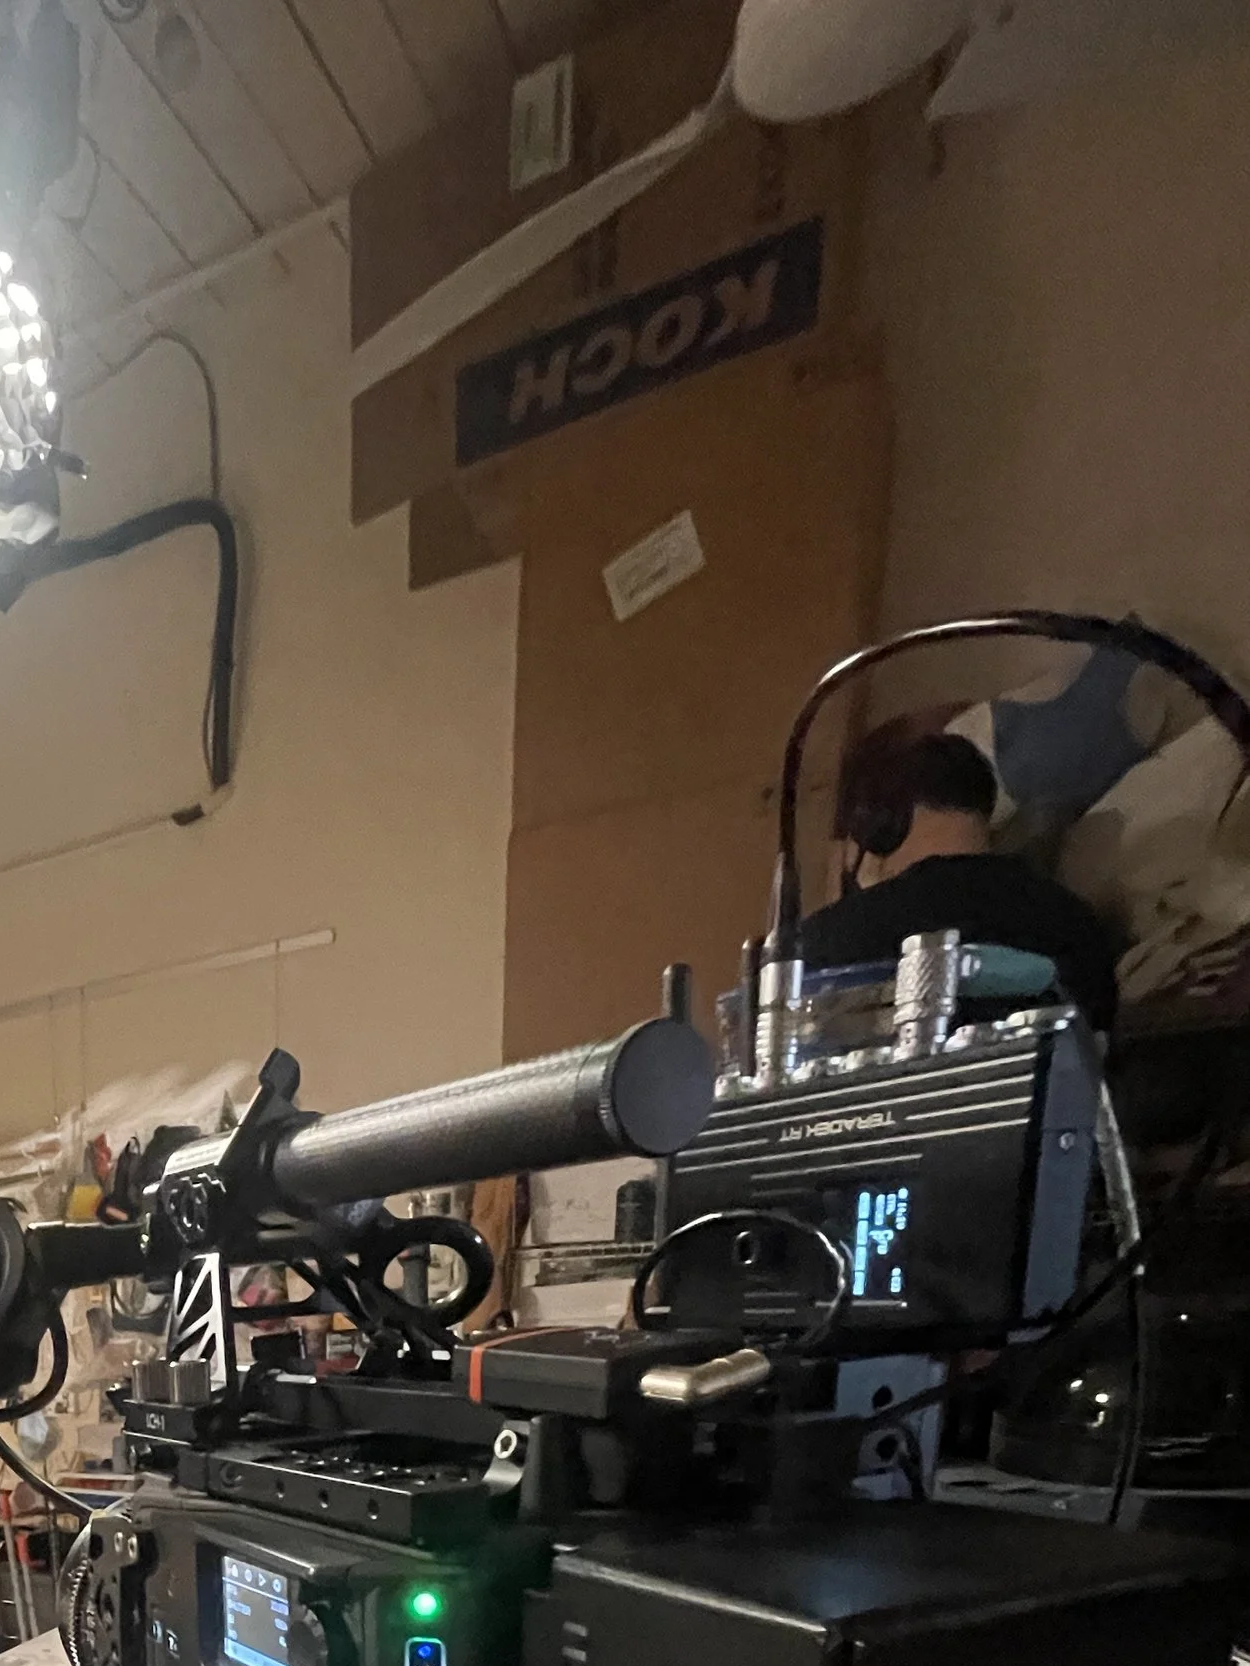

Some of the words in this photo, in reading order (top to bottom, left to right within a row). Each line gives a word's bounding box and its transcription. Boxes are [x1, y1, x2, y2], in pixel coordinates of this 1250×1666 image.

[508, 258, 781, 424] KOCH
[778, 1126, 803, 1142] RT
[805, 1110, 897, 1138] TERADEK
